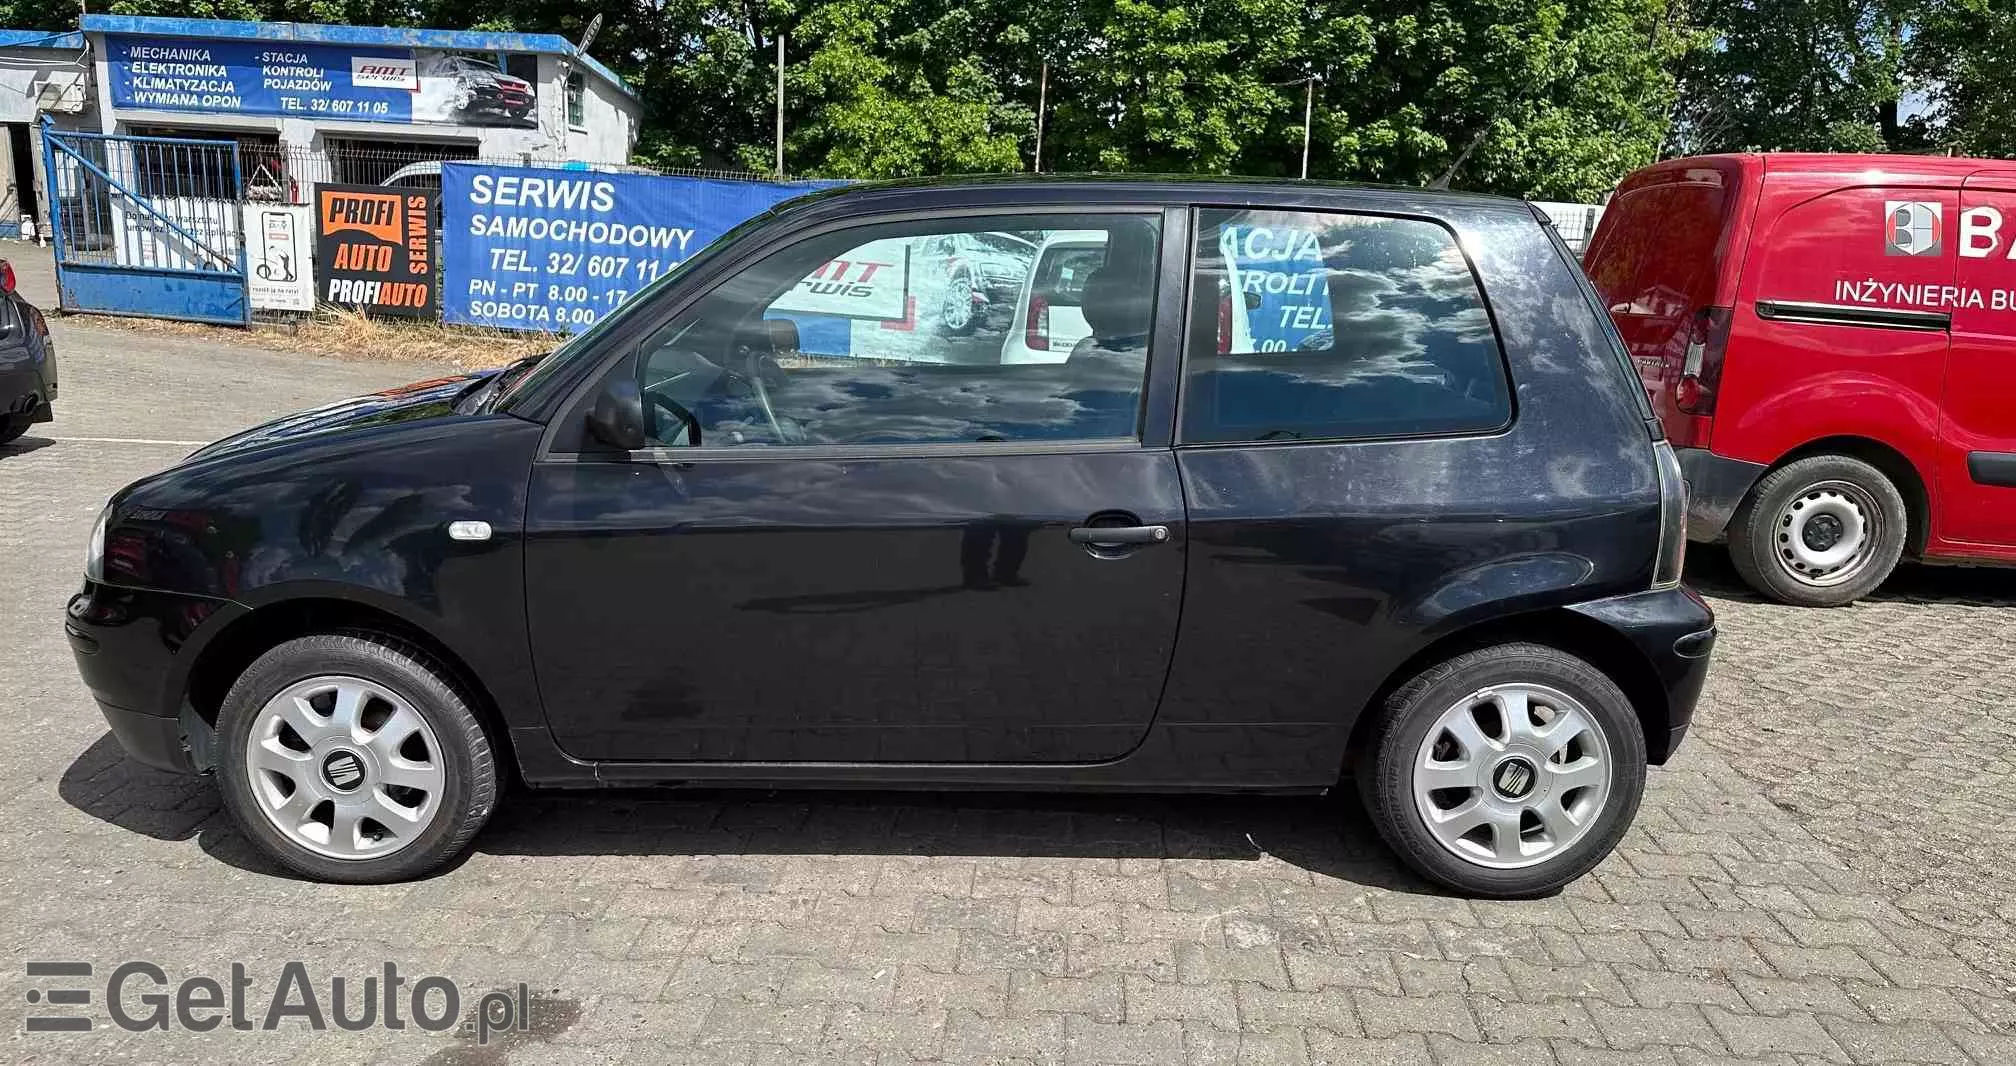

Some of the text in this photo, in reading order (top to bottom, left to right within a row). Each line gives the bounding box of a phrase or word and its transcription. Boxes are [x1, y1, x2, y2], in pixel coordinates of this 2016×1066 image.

[130, 46, 211, 61] MECHANIKA
[262, 52, 308, 64] STACJA
[132, 62, 227, 77] ELEKTRONIKA
[262, 65, 324, 78] KONTROLI
[133, 76, 235, 93] KLIMATYZACJA
[263, 78, 332, 91] POJAZDÓW
[134, 91, 199, 106] WYMIANA
[202, 95, 241, 108] OPON
[280, 97, 388, 113] TEL. 32/ 607 11 05
[470, 175, 615, 211] SERWIS
[329, 197, 396, 226] PROFI
[407, 195, 428, 275] SERWIS
[470, 214, 695, 250] SAMOCHODOWY
[1960, 206, 2016, 259] B
[1220, 227, 1323, 262] ACJA
[334, 243, 393, 272] AUTO
[490, 248, 538, 273] TEL.
[546, 252, 584, 276] 32/
[588, 256, 630, 278] 607
[636, 259, 660, 282] 11
[328, 279, 428, 307] PROFIAUTO
[469, 279, 496, 297] PN
[513, 282, 538, 299] PT
[548, 285, 587, 302] 8.00
[1835, 277, 1984, 309] INŻYNIERIA
[470, 301, 595, 324] SOBOTA 8.00
[1280, 305, 1333, 329] TEL.
